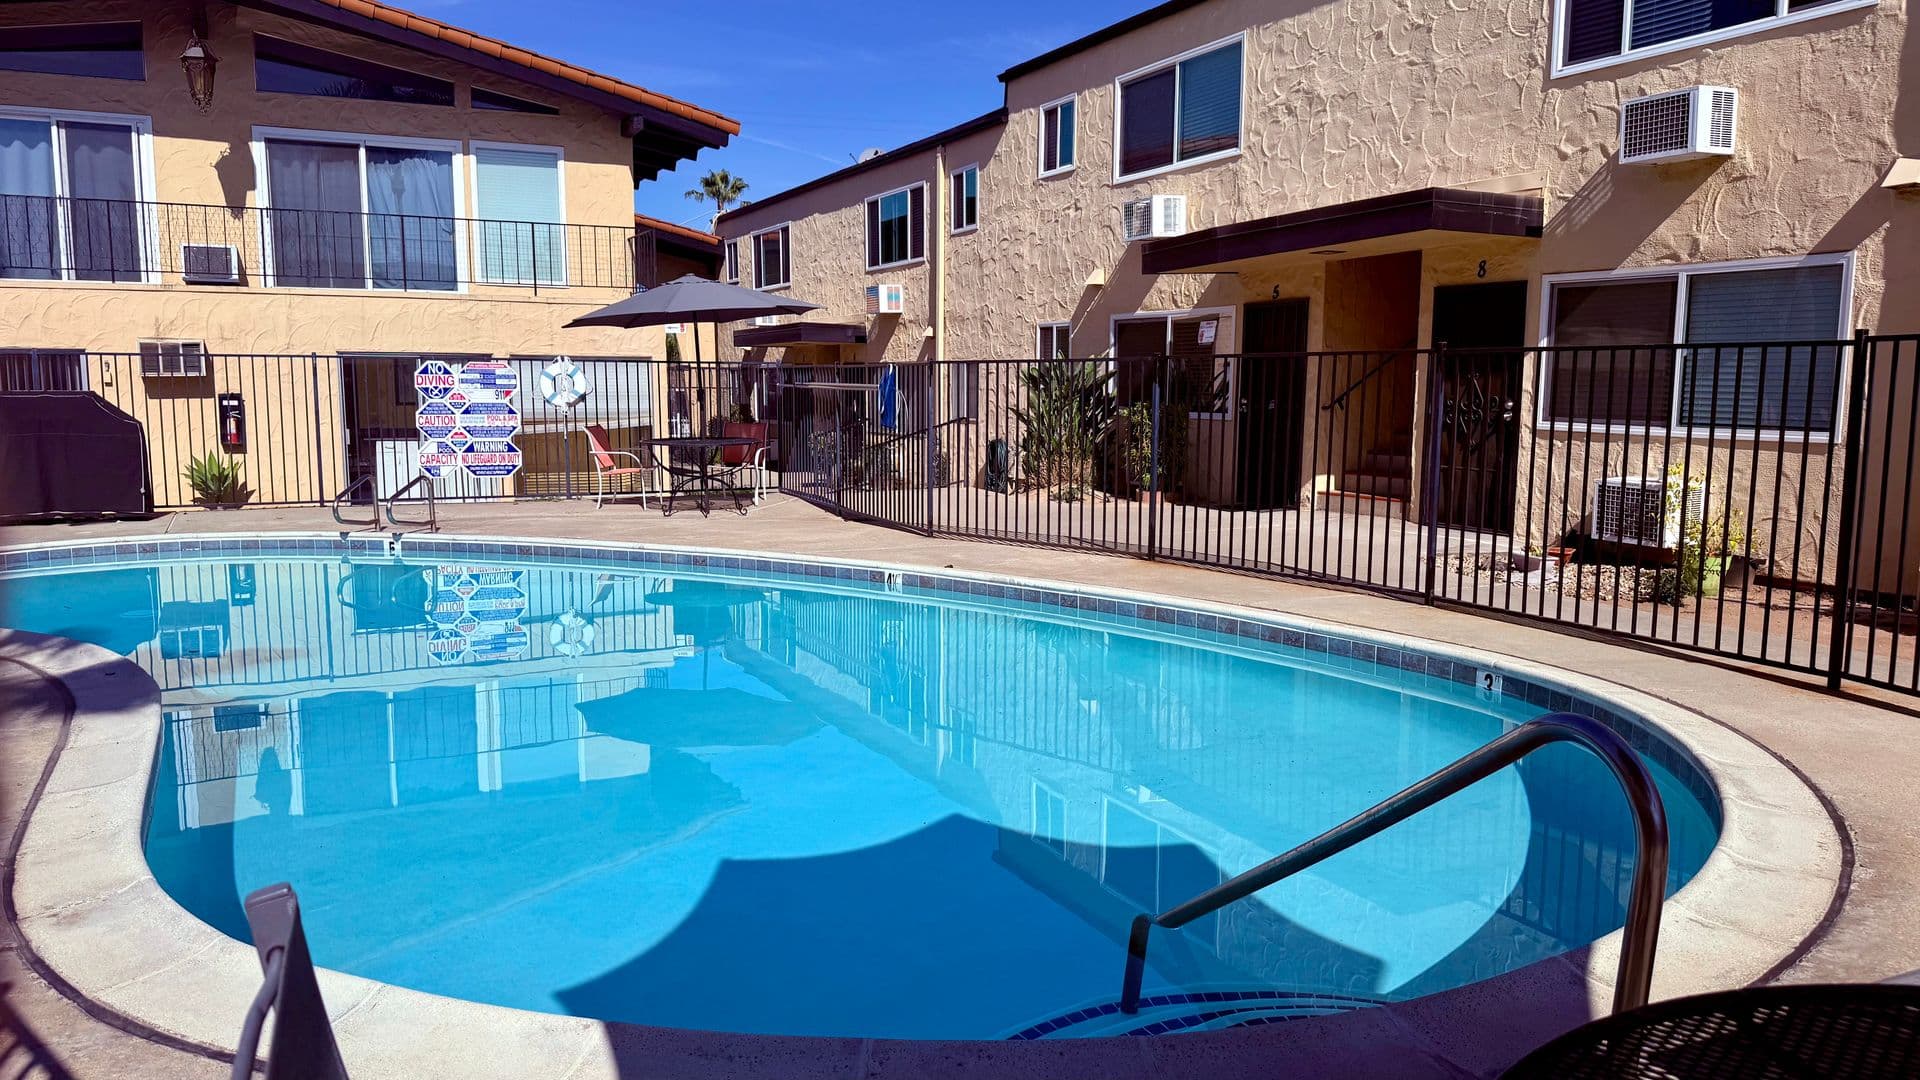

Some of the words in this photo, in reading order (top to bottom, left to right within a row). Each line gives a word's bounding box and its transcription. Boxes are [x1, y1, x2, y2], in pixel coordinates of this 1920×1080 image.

[1477, 260, 1487, 278] 8
[1272, 284, 1280, 299] 5
[428, 363, 444, 374] NO
[416, 375, 455, 386] DIVING
[494, 390, 505, 401] 911
[418, 416, 456, 426] CAUTION
[473, 441, 508, 452] WARNING
[419, 454, 458, 465] CAPACITY
[462, 454, 469, 464] NO
[471, 454, 497, 464] LIFEGUARD
[498, 454, 506, 464] ON
[507, 454, 520, 464] DUTY
